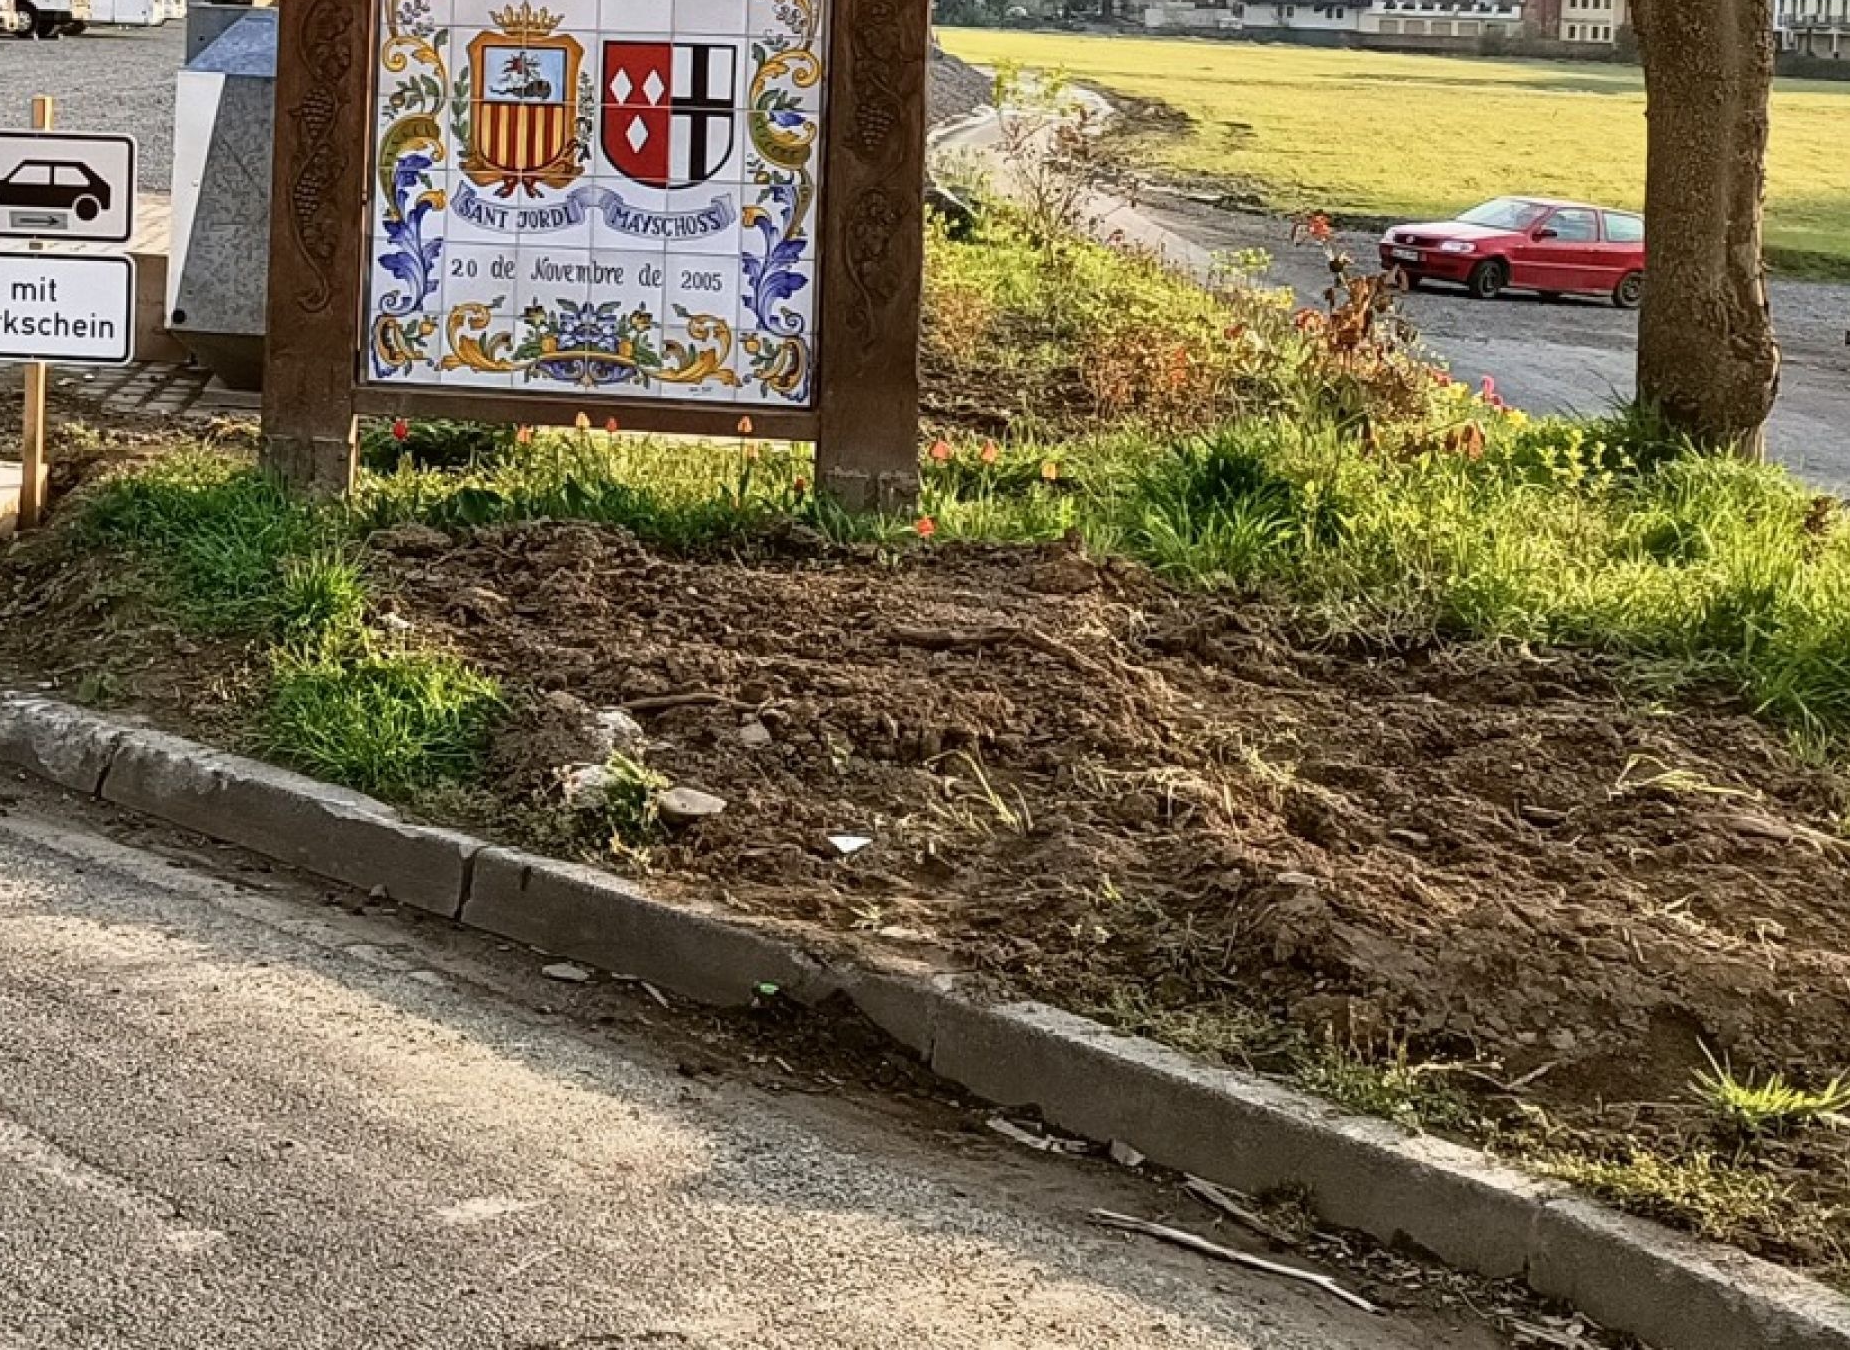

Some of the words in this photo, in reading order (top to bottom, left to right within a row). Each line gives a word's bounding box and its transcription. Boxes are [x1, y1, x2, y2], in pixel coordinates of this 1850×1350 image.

[464, 199, 508, 229] SANT
[516, 206, 577, 229] JORDI
[611, 207, 722, 237] MAYSCHOSS
[11, 276, 57, 303] mit
[451, 258, 478, 278] 20
[490, 255, 516, 280] de
[530, 256, 624, 285] Novembre
[638, 263, 663, 288] de
[681, 270, 723, 291] 2005
